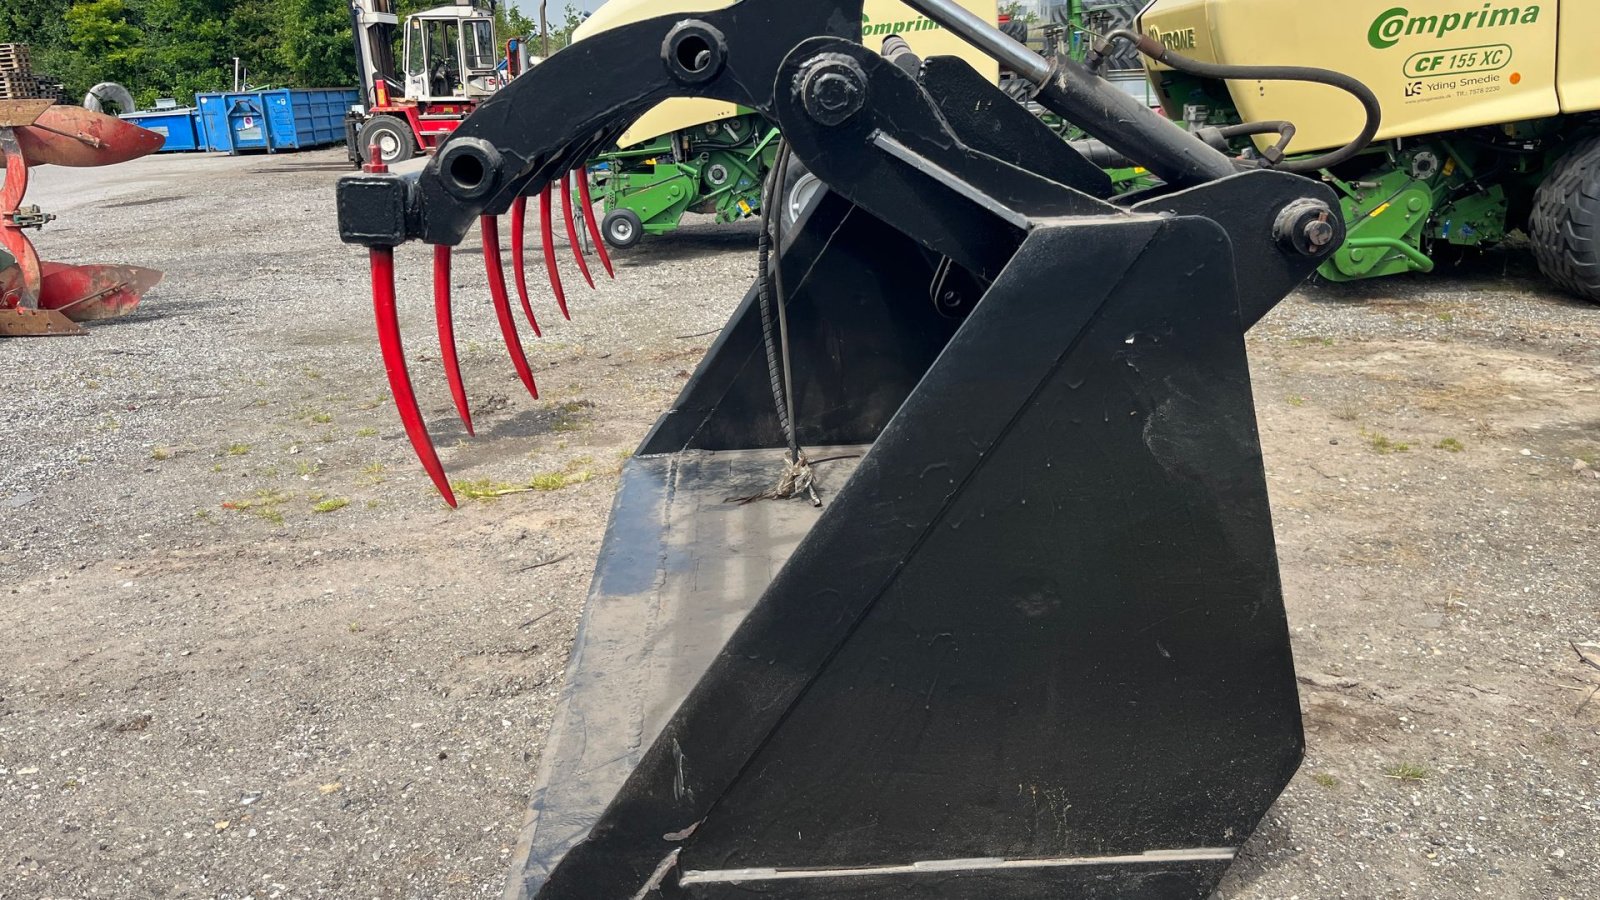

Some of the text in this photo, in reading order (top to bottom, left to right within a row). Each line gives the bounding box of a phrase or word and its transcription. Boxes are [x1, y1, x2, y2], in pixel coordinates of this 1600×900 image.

[863, 13, 940, 35] omprim
[1368, 3, 1540, 49] Comprima
[1160, 28, 1195, 50] KRONE
[1414, 49, 1503, 73] CF 155 XC
[1427, 74, 1500, 91] Yding Smedie
